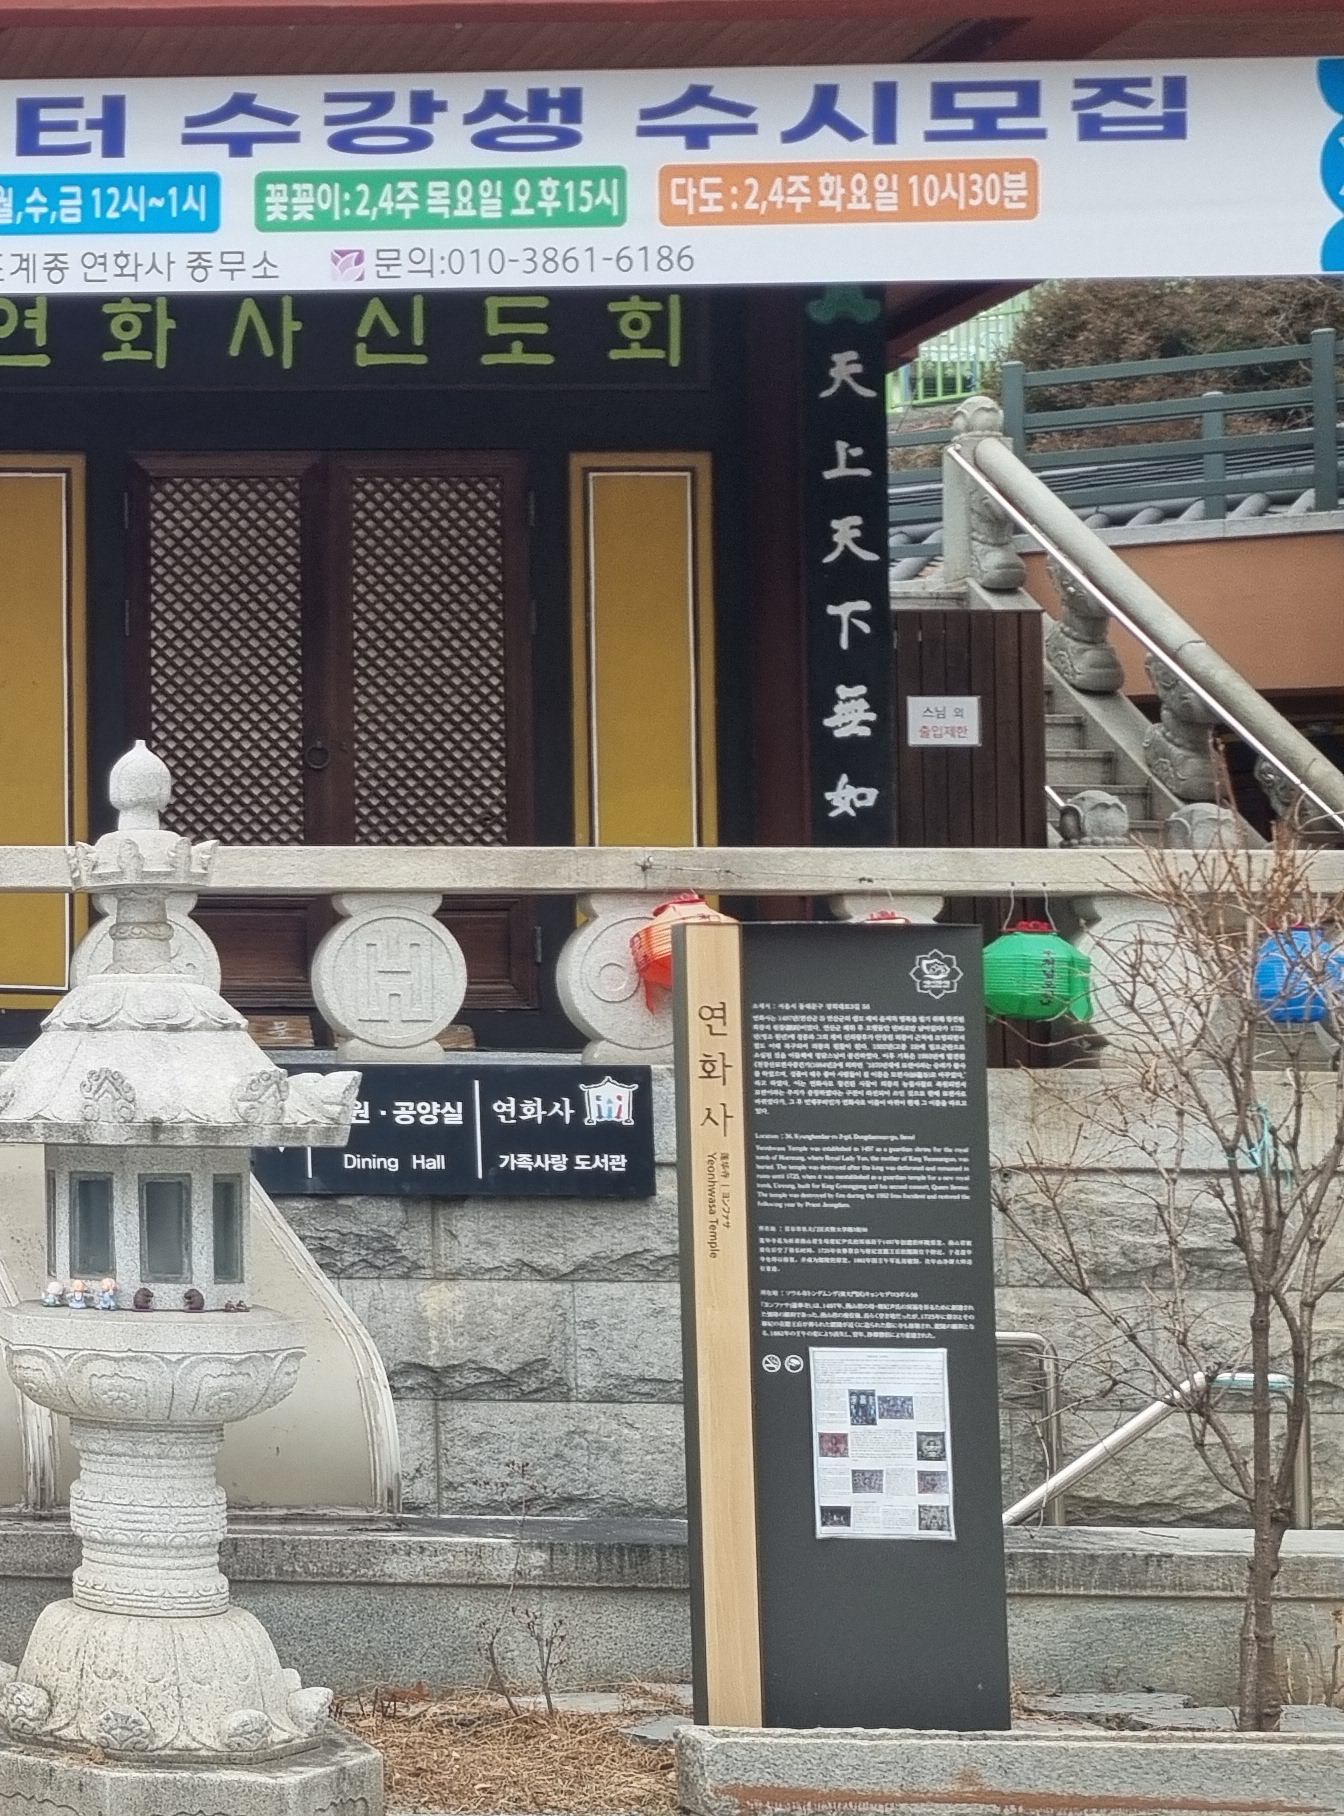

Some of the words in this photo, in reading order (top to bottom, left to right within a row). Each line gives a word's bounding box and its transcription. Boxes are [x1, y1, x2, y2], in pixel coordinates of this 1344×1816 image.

[182, 87, 583, 157] 수강생
[634, 74, 1189, 150] 수시모집
[92, 185, 205, 221] 12시~1시
[427, 179, 502, 218] 목요일
[511, 177, 619, 216] 오후15시
[818, 173, 898, 212] 화요일
[909, 172, 1028, 209] 10시30분
[81, 250, 175, 282] 연화사
[187, 251, 279, 283] 종무소
[922, 706, 947, 719] 스님
[919, 725, 968, 739] 출입제한
[493, 1097, 575, 1124] 연화사
[344, 1154, 398, 1171] Dining
[413, 1155, 445, 1169] Hall
[499, 1154, 568, 1171] 가족사랑
[574, 1154, 627, 1171] 도서관
[706, 1152, 718, 1215] Yeonhwasa
[708, 1218, 721, 1259] Temple
